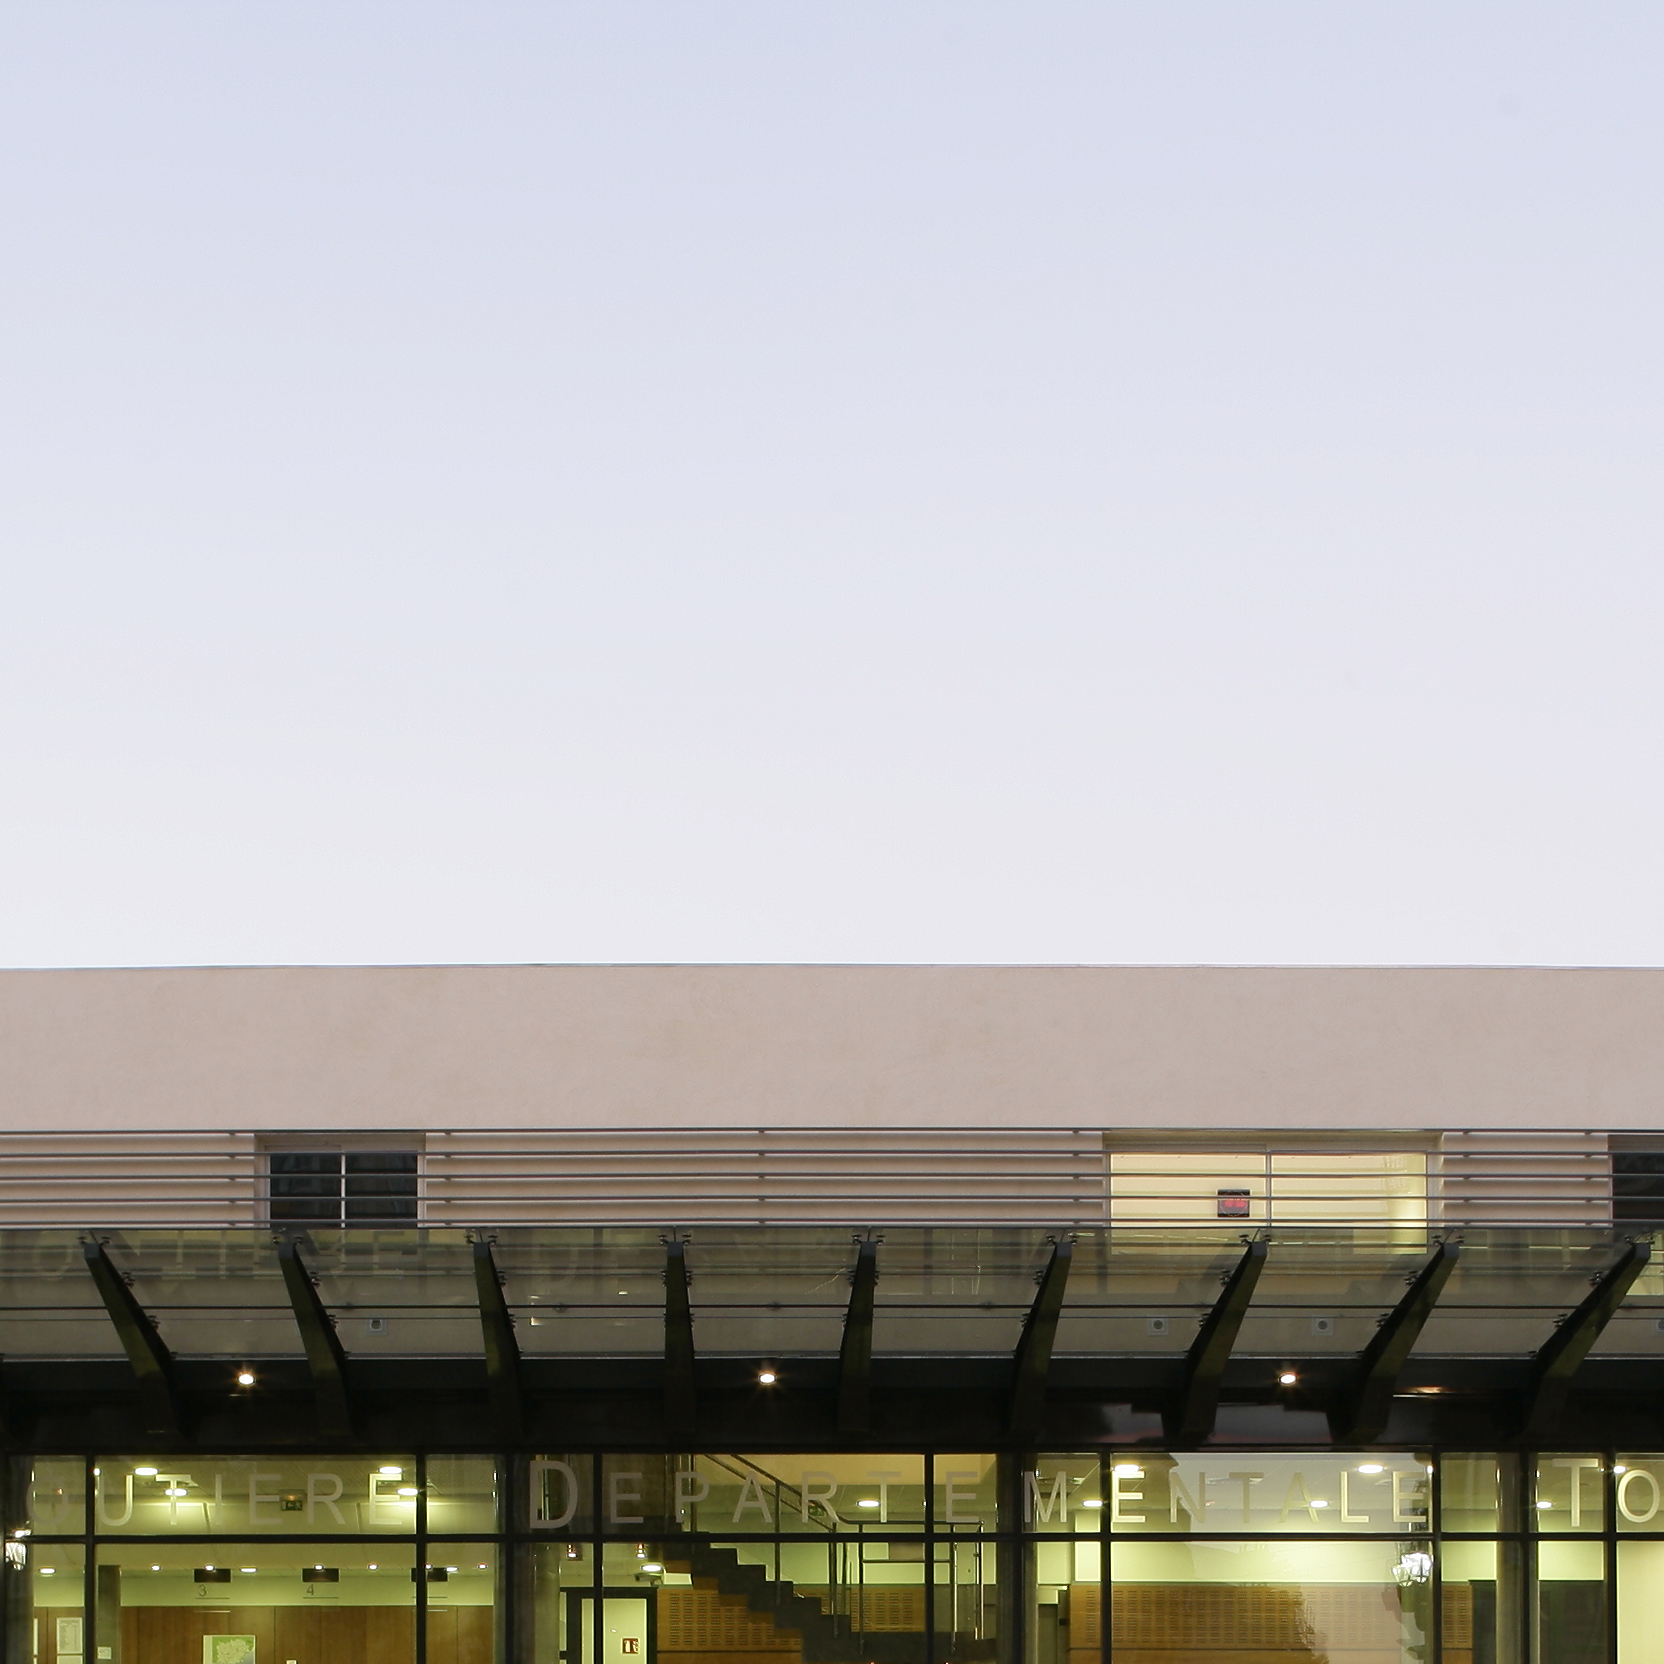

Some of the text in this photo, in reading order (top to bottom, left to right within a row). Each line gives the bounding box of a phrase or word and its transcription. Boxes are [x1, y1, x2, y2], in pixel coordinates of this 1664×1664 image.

[529, 1459, 1428, 1530] DEPARTEMENTALE
[198, 1583, 208, 1597] 3
[306, 1583, 316, 1597] 4
